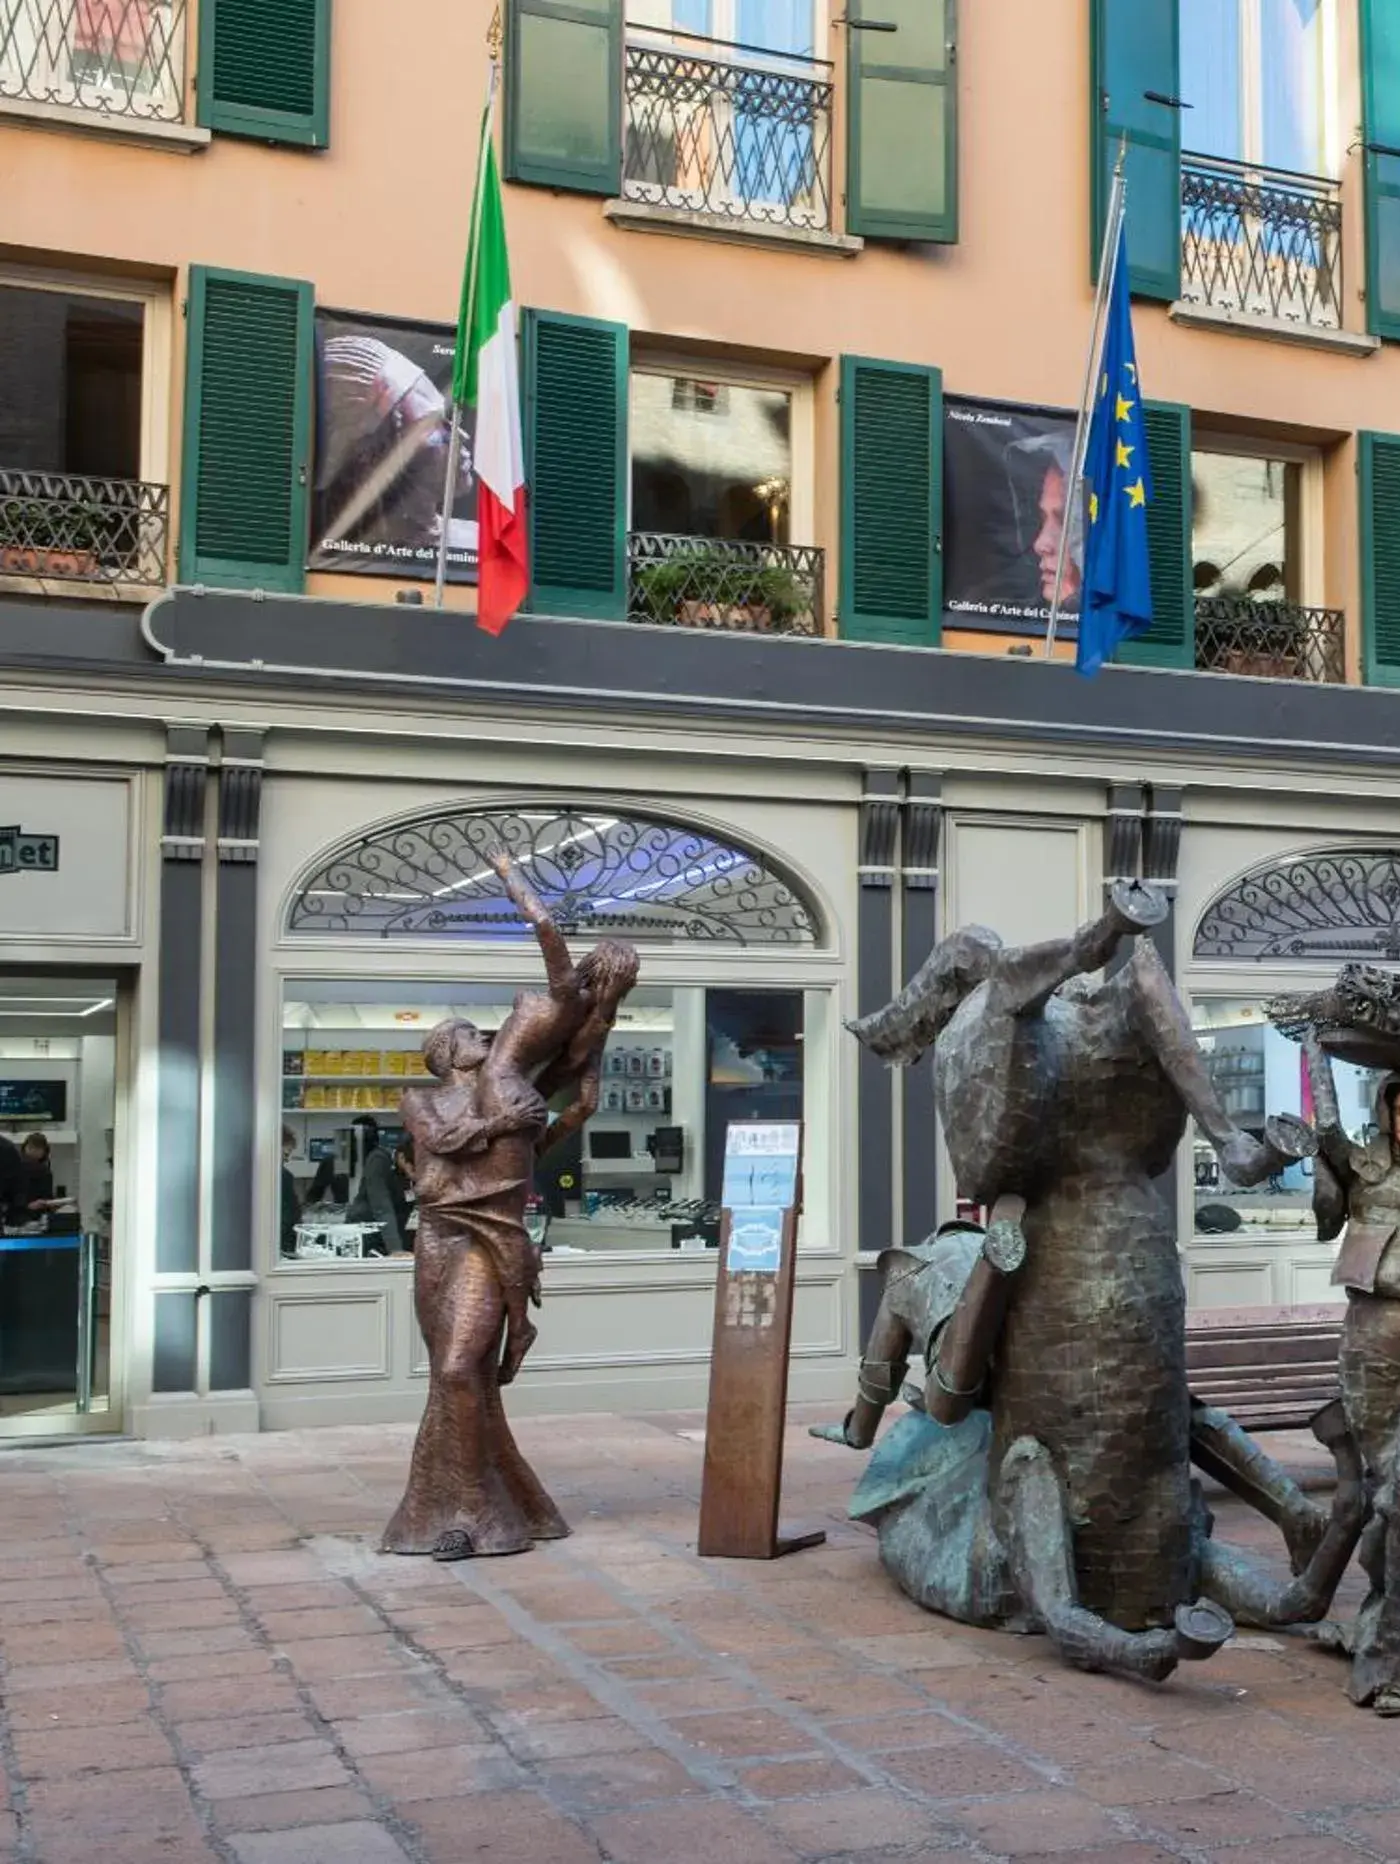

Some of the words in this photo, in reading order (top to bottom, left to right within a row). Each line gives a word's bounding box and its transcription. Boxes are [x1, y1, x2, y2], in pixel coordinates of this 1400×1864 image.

[321, 538, 371, 554] Galleria
[373, 544, 413, 558] d'Arte
[415, 548, 434, 560] del
[948, 600, 989, 613] Galleria
[990, 603, 1022, 616] d'Arte
[1023, 607, 1038, 618] del
